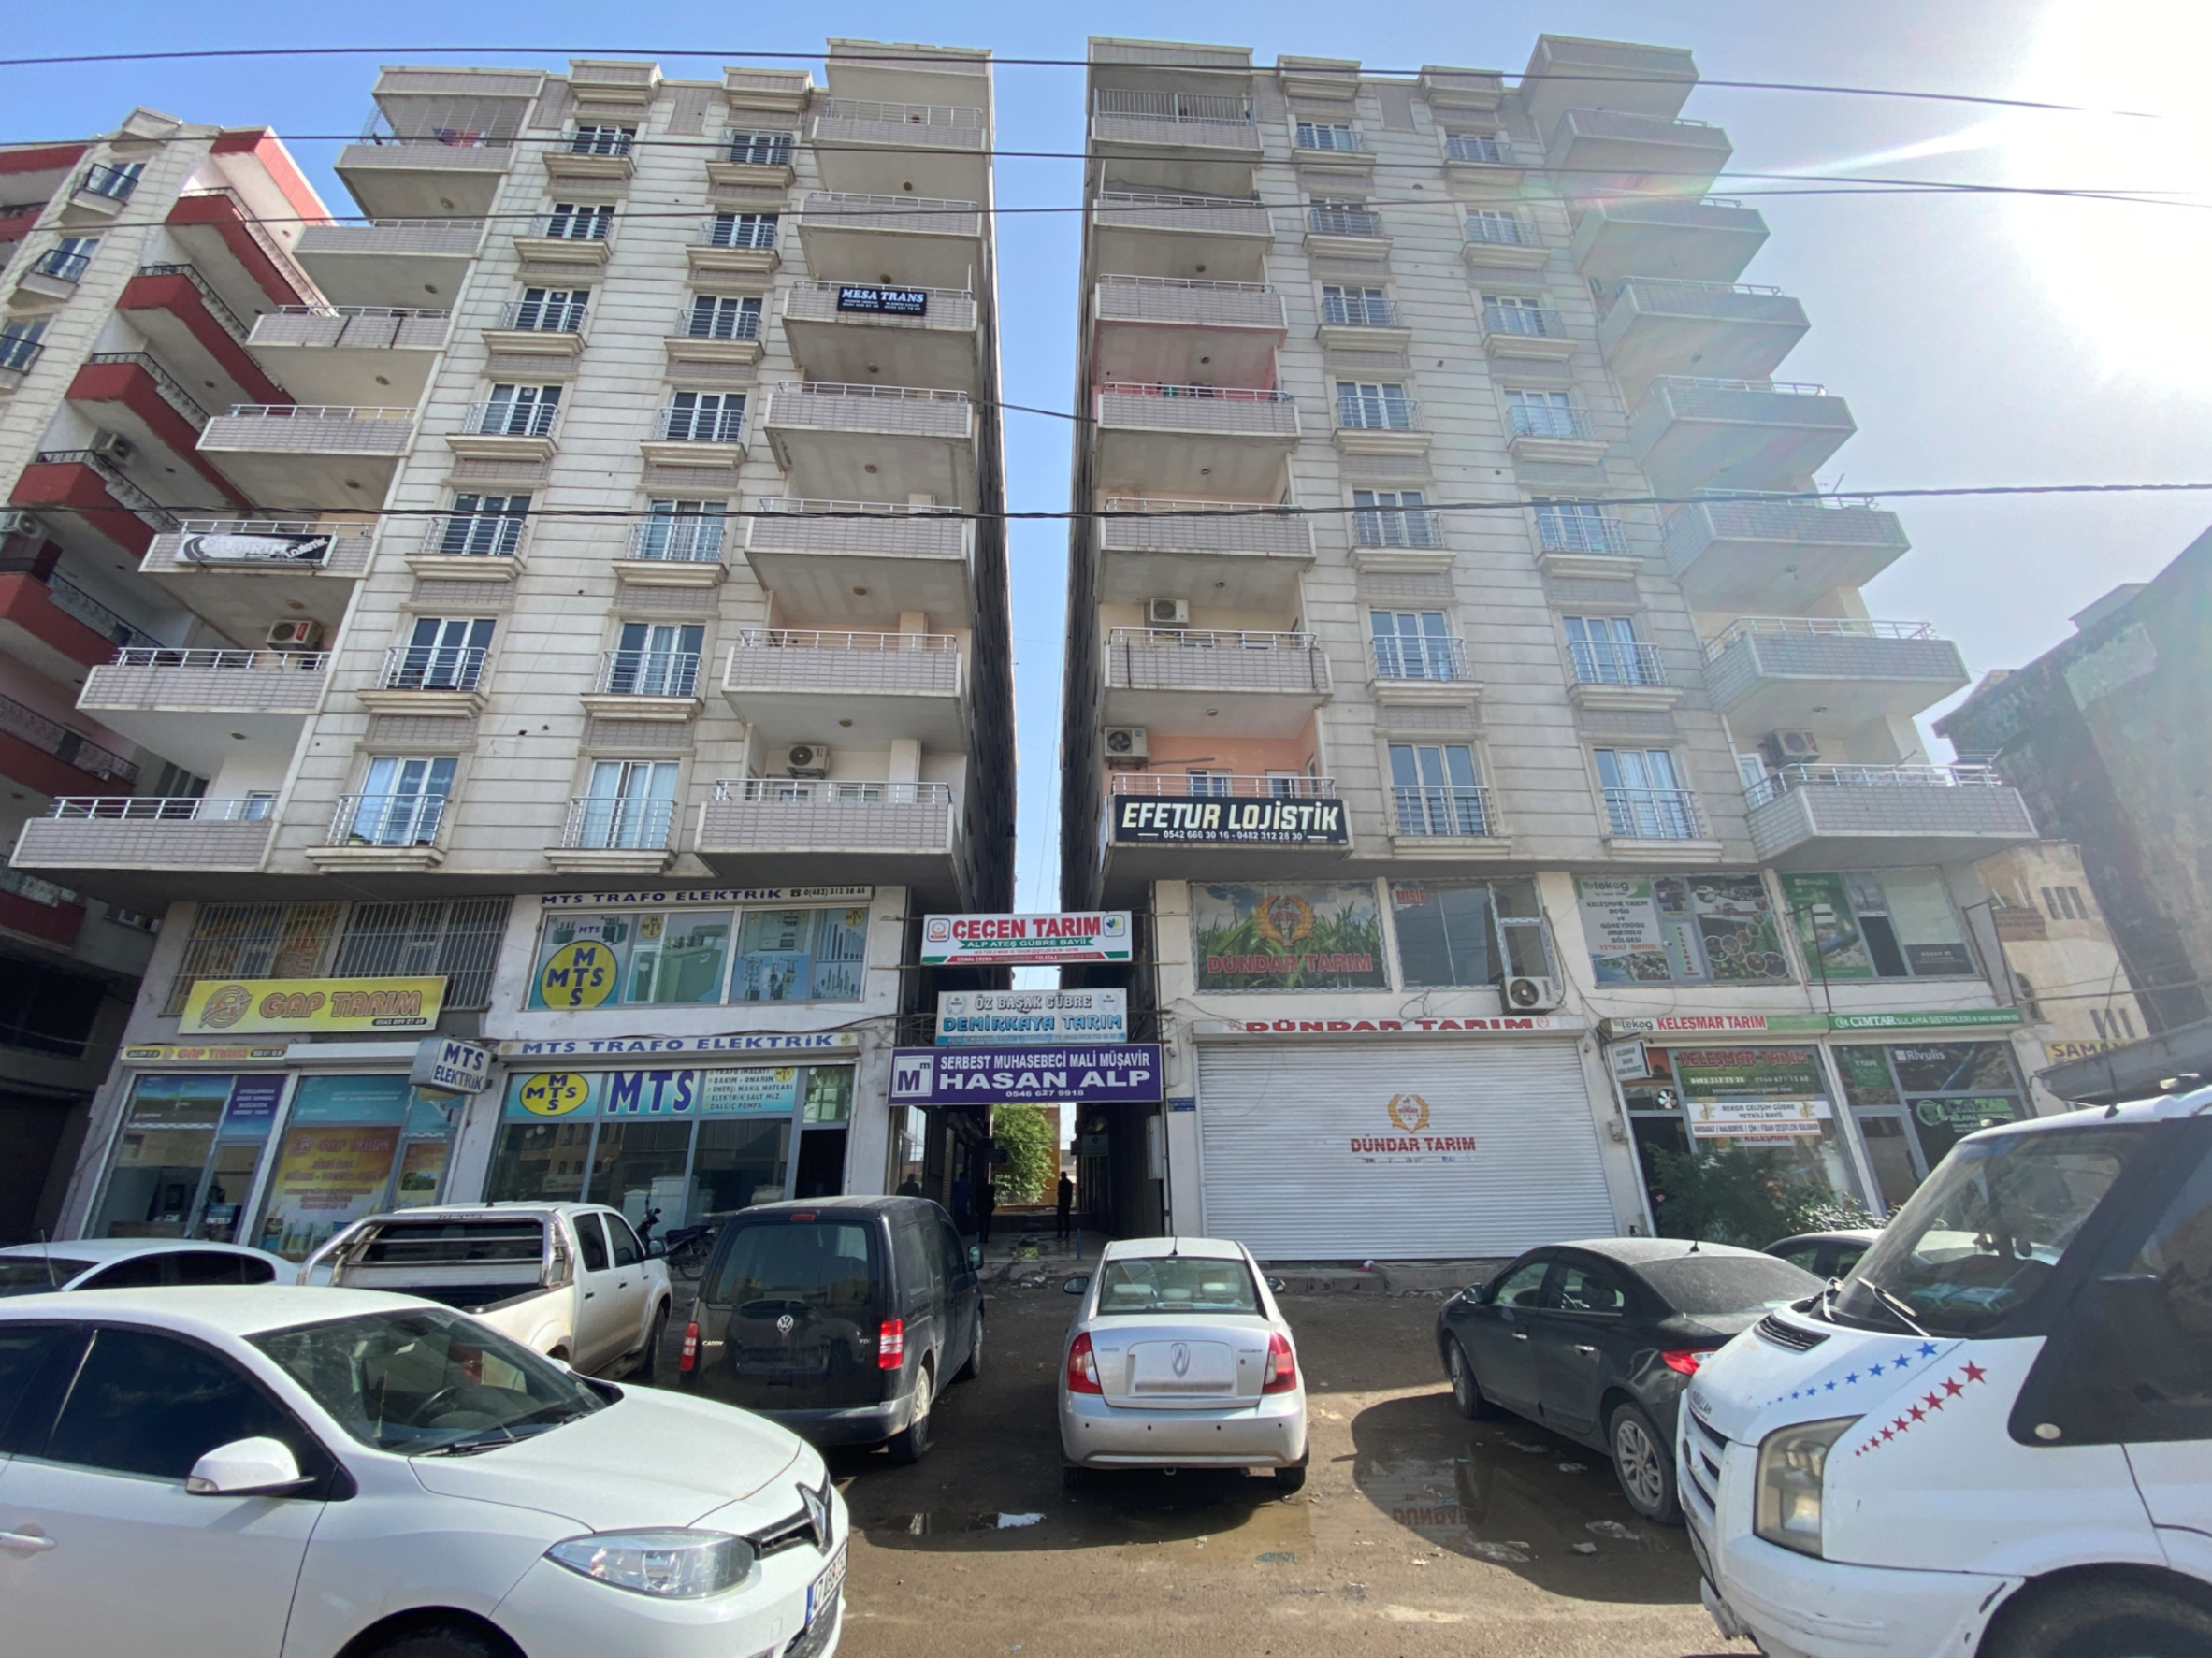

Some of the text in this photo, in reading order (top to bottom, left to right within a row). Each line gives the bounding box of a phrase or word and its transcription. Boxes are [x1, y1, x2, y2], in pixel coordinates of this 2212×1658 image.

[842, 288, 924, 303] MESA TRANS
[1122, 800, 1339, 830] EFETUR LOJİSTİK
[1187, 830, 1203, 839] 666
[1205, 830, 1216, 839] 30
[1236, 831, 1259, 840] 0482
[1292, 832, 1303, 841] 30
[541, 895, 584, 904] MTS
[593, 892, 666, 902] TRAFO
[675, 888, 782, 901] ELEKTRİK
[952, 916, 1101, 940] ÇEÇEN TARIM
[1207, 951, 1373, 974] DÜNDAR TARIM
[546, 967, 604, 988] MTS
[260, 990, 422, 1018] GAP TARIM
[976, 993, 1092, 1014] ÖZ BAŞAK GÜBRE
[943, 1014, 1122, 1032] DEMİRKAYA TARIM
[1246, 1018, 1534, 1032] DÜNDAR TARIM
[1727, 1016, 1766, 1029] TARIM
[522, 1042, 576, 1054] MTS
[589, 1040, 684, 1052] TRAFO
[697, 1034, 834, 1049] ELEKTRİK
[178, 1049, 206, 1059] GAP
[209, 1049, 247, 1059] TARIM
[443, 1042, 484, 1071] MTS
[941, 1049, 1150, 1071] SERBEST MUHASEBECİ MALİ MÜŞAVİR
[1760, 1050, 1809, 1066] TARIM
[1906, 1049, 1945, 1060] Rivulis
[433, 1064, 484, 1090] ELEKTRİK
[939, 1070, 1150, 1089] HASAN ALP
[526, 1087, 577, 1099] MTS
[608, 1070, 696, 1112] MTS
[1350, 1133, 1476, 1152] DÜNDAR TARIM
